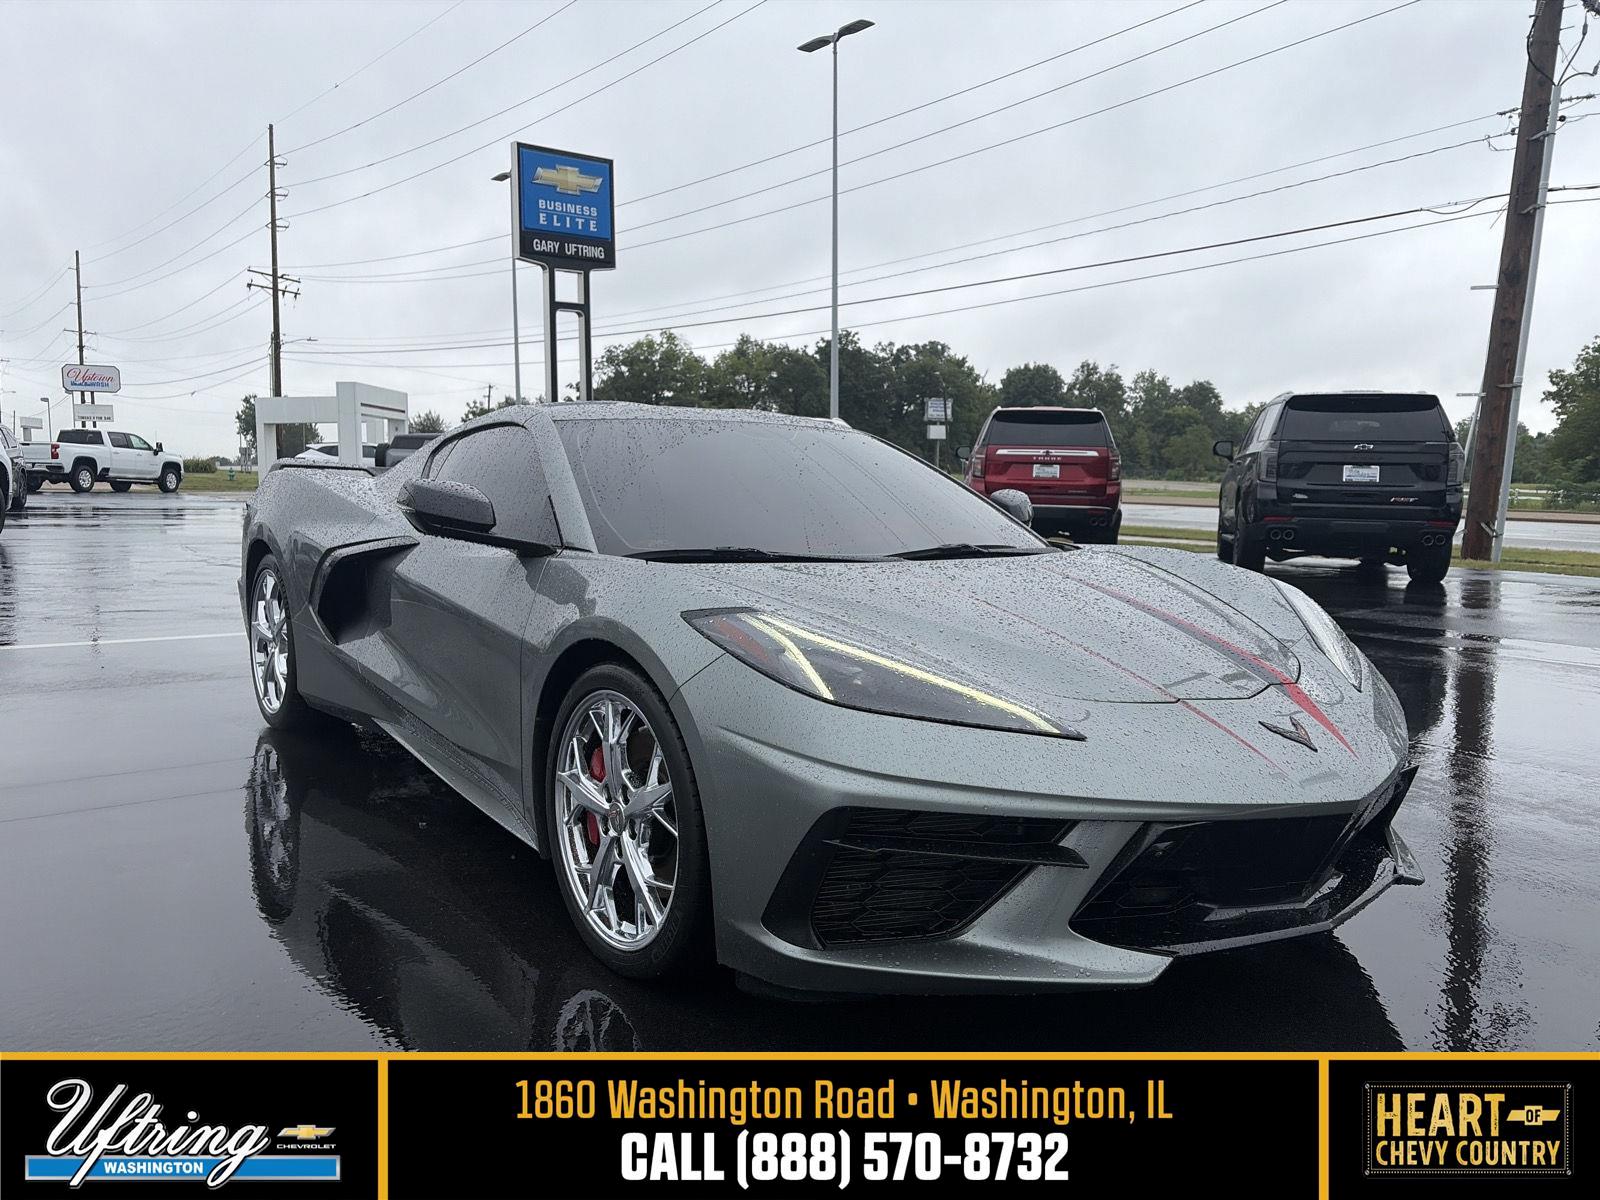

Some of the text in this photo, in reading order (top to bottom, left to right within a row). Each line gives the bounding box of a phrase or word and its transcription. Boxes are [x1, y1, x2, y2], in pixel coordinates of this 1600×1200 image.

[538, 199, 598, 217] BUSINESS
[539, 213, 598, 232] ELITE
[533, 238, 605, 259] GARY UFTRING
[67, 368, 113, 383] Uptown
